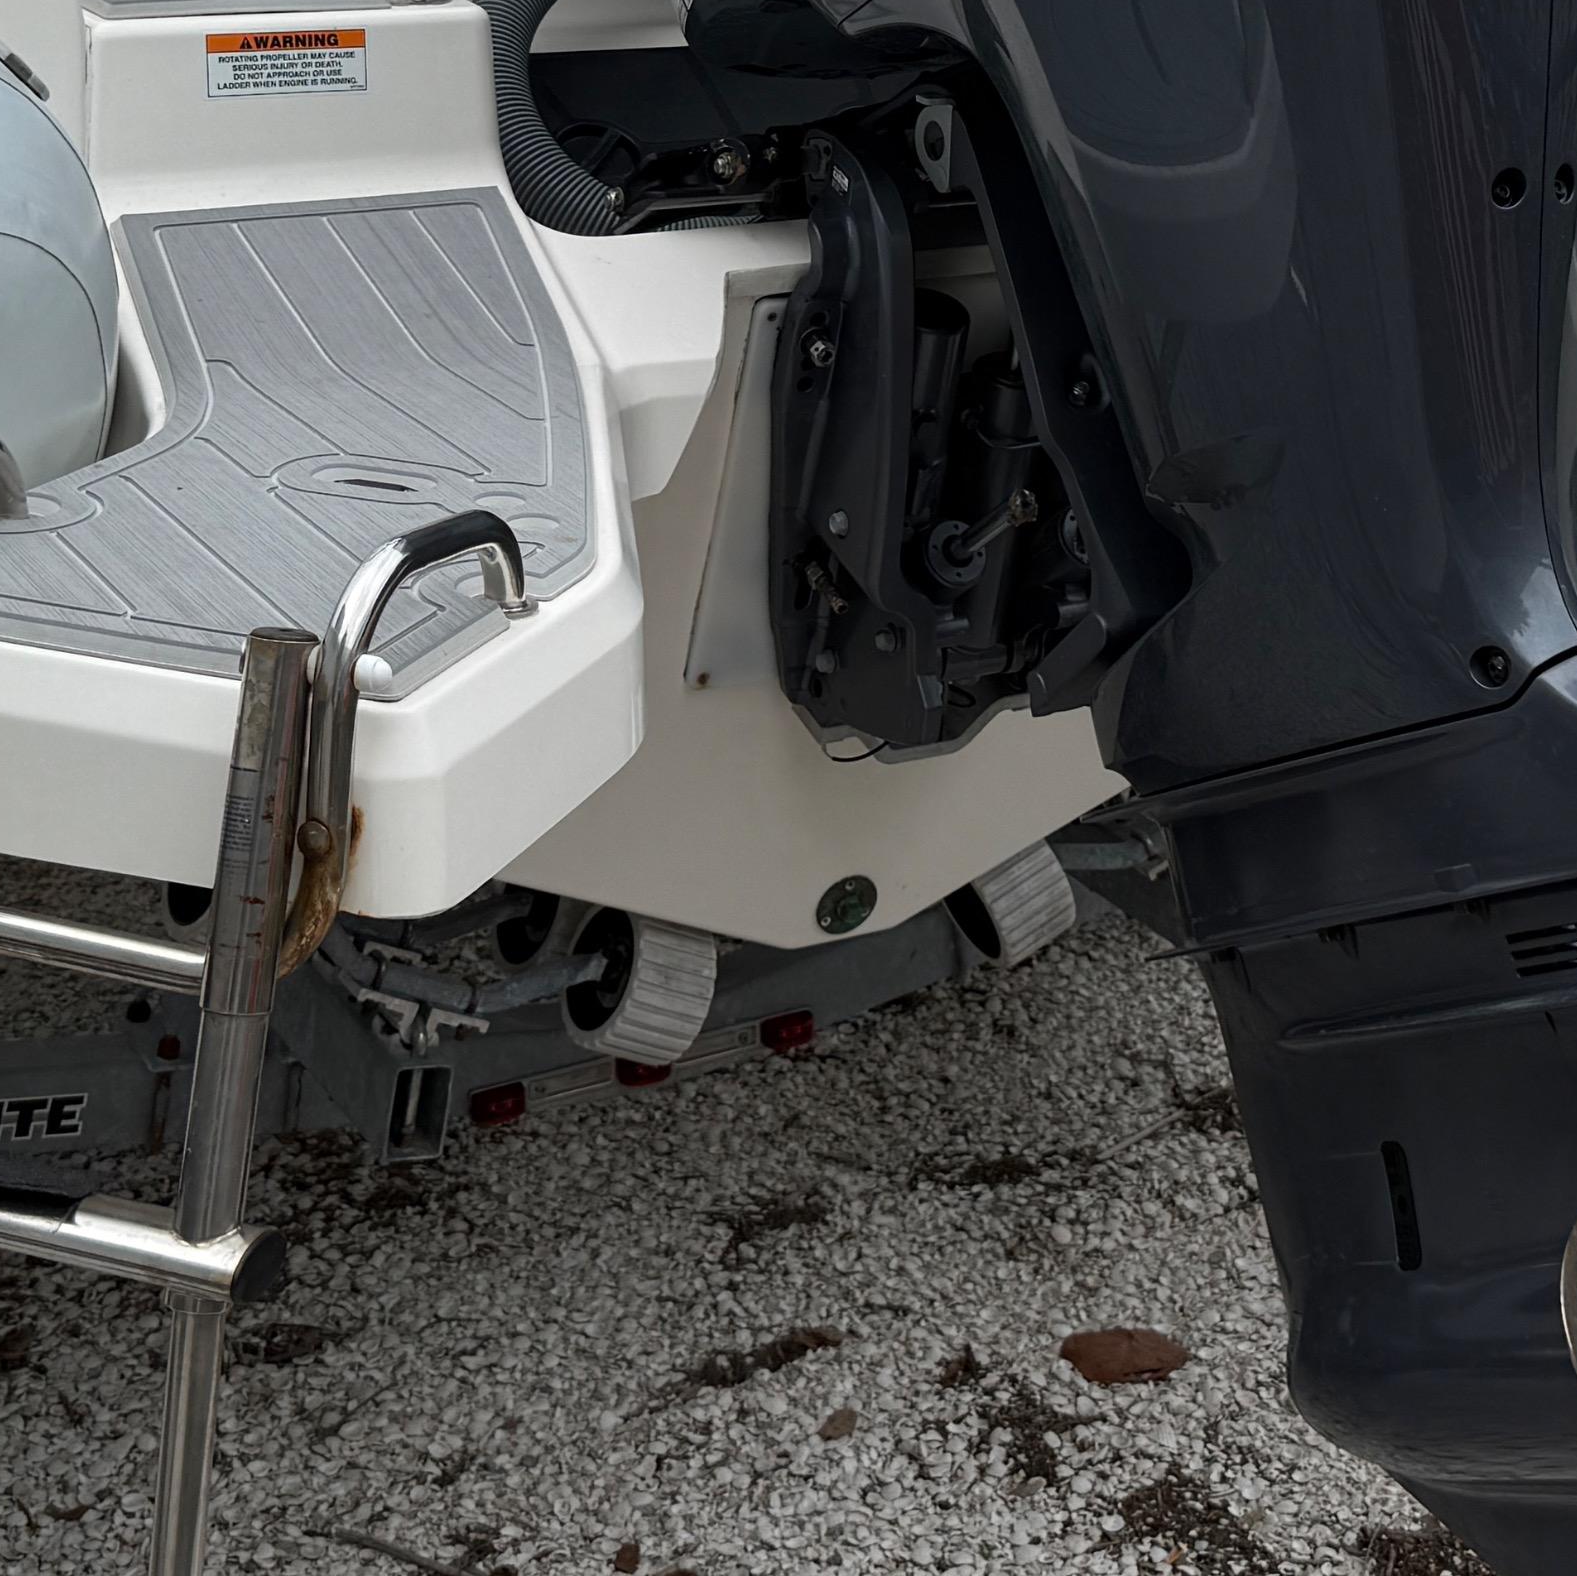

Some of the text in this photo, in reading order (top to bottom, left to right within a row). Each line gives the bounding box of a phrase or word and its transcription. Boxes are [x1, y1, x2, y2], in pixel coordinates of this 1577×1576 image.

[254, 33, 339, 49] WARNING
[218, 51, 356, 63] ROTATING PROPELLER MAY CAUSE
[232, 63, 269, 72] SERIOUS
[270, 62, 299, 70] INJURY
[301, 61, 313, 69] OR
[233, 69, 342, 81] DO NOT APPROACH OR USE
[217, 81, 251, 90] LADDER
[252, 79, 276, 89] WHEN
[279, 78, 309, 87] ENGINE
[311, 78, 319, 86] IS
